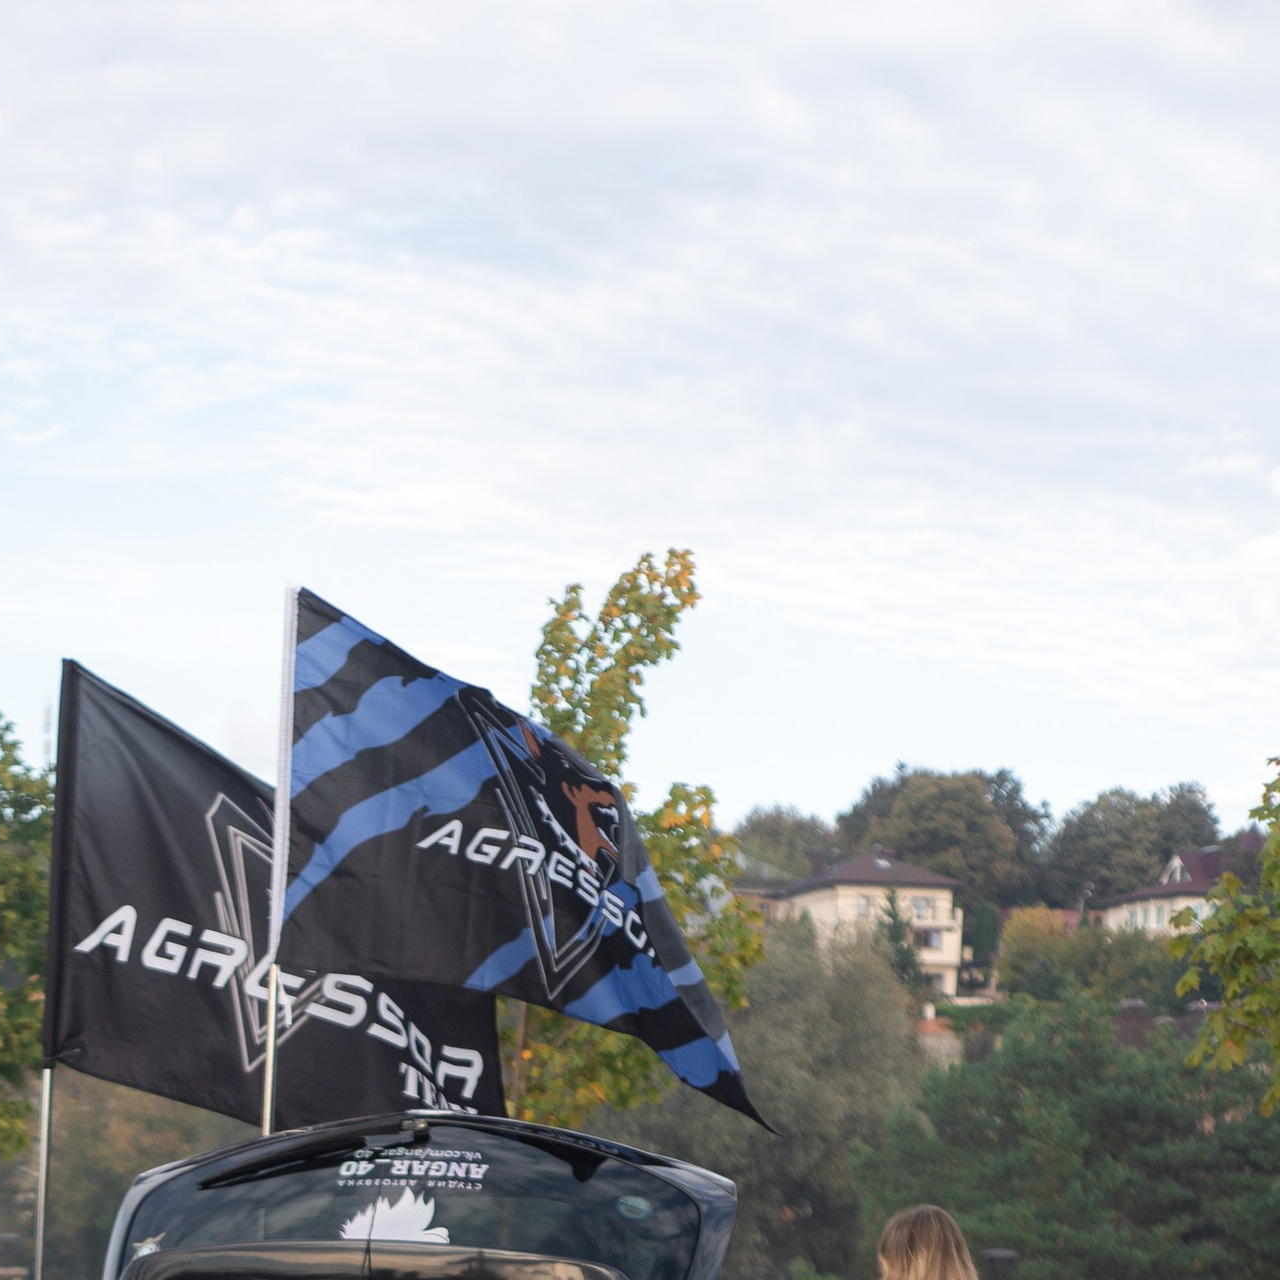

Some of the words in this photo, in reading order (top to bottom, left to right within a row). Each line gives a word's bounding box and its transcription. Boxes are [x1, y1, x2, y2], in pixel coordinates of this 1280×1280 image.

[417, 819, 656, 959] AGRESSO
[74, 904, 484, 1100] AGRESSOR
[399, 1062, 478, 1115] TE
[354, 1147, 482, 1161] vk.com/angar_40
[339, 1158, 490, 1180] ANGAR_40
[336, 1178, 418, 1188] АВТОЗВУКА
[426, 1180, 483, 1190] СТУДИЯ
